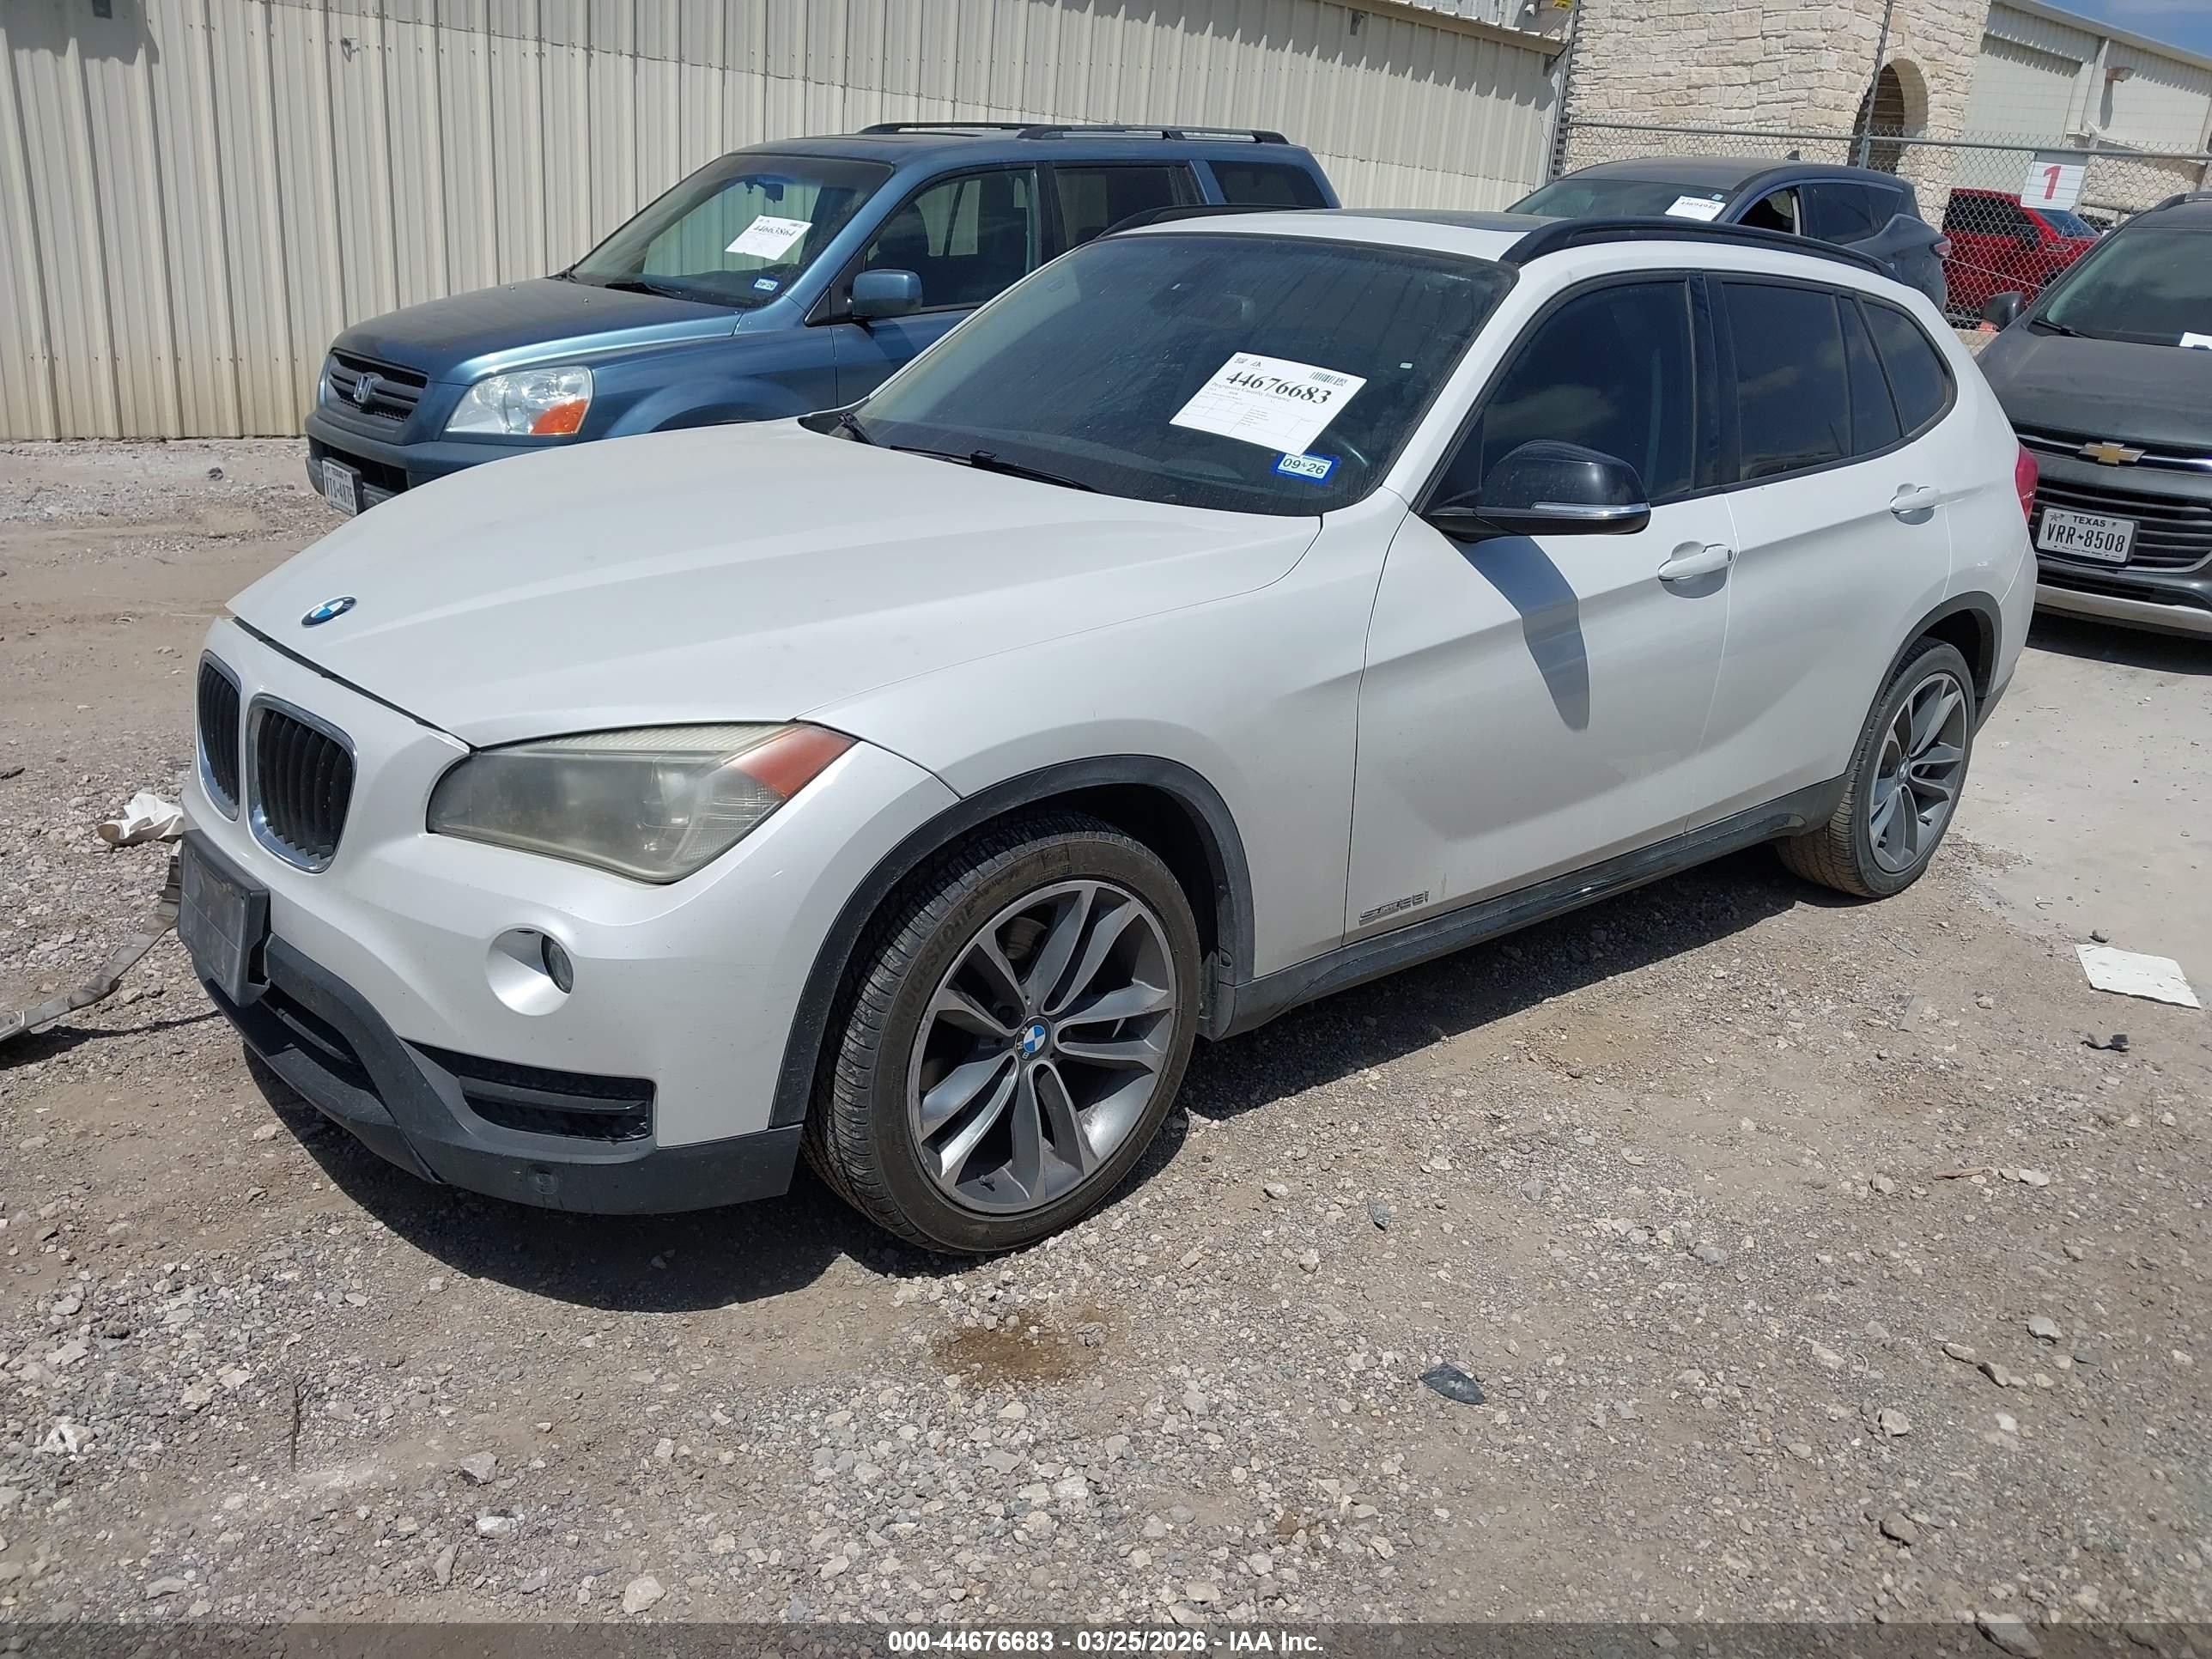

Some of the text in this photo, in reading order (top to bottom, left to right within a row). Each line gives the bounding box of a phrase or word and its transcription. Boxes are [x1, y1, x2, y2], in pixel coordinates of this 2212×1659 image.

[2044, 166, 2061, 199] 1
[1226, 371, 1332, 404] 44676683
[2073, 515, 2106, 527] TEXAS
[1017, 1026, 1030, 1059] BMW
